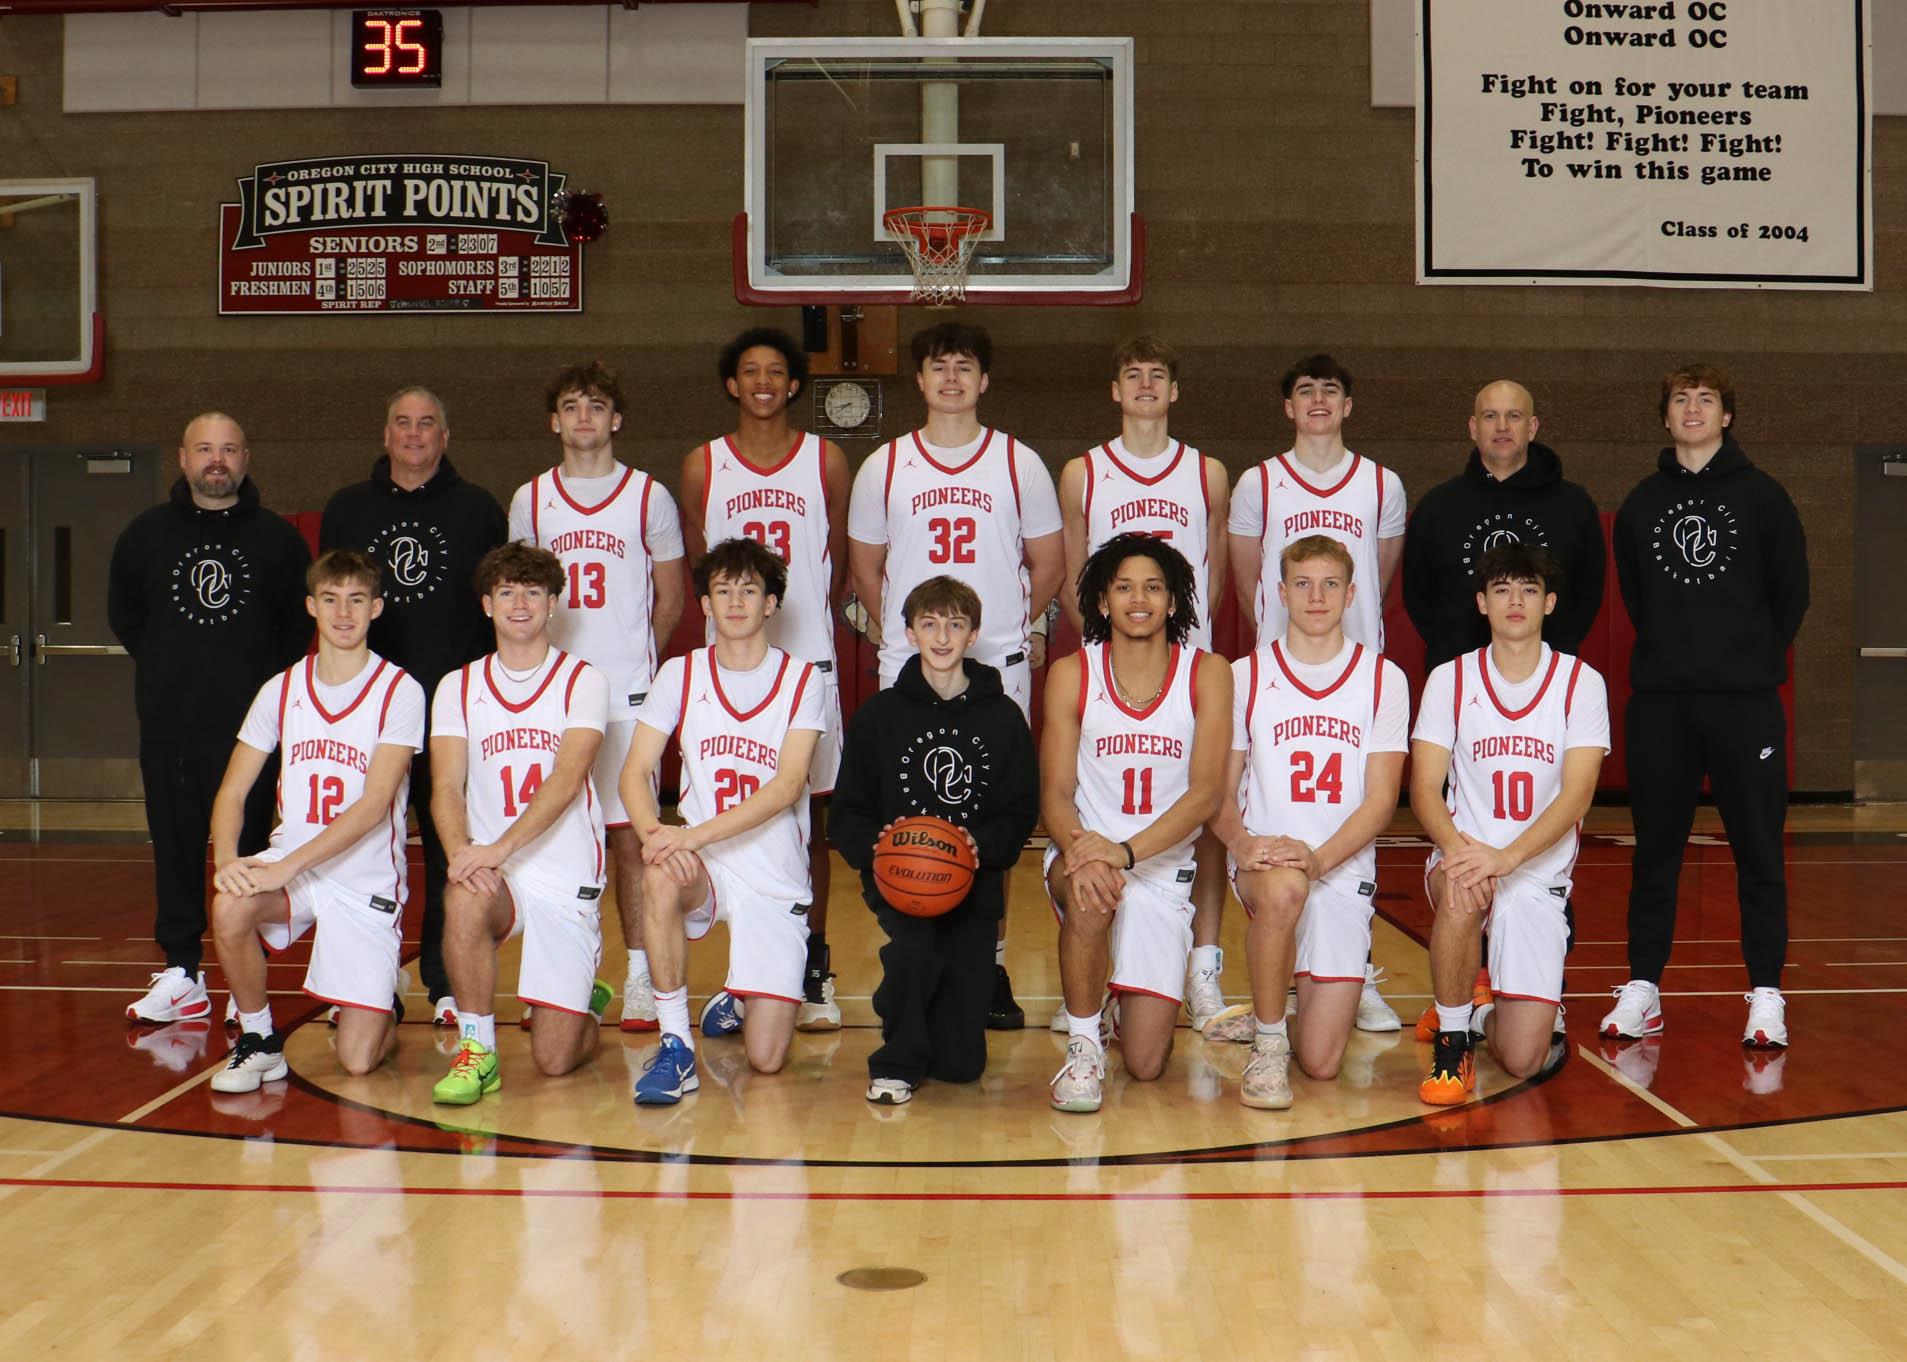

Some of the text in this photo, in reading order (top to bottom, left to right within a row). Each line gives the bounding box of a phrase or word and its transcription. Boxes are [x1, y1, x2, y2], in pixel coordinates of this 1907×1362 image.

[1564, 0, 1727, 21] Onward OC
[364, 20, 425, 74] 35
[1564, 26, 1727, 48] Onward OC
[1481, 74, 1809, 101] Fight on for your team
[1540, 103, 1752, 128] Fight, Pioneers
[1510, 130, 1781, 157] Fight! Fight! Fight!
[287, 163, 514, 181] OREGON CITY HIGH SCHOOL
[1522, 158, 1772, 185] To win this game
[264, 179, 539, 226] SPIRIT POINTS
[309, 236, 497, 254] SENIORS 2nd 2307
[1661, 221, 1809, 242] Class of 2004
[250, 261, 385, 276] JUNIORS 1st 2525
[399, 260, 569, 275] SOPHOMORES 3rd 2212
[231, 281, 385, 297] FRESHMEN 4th 1506
[448, 280, 569, 296] STAFF 5th 1057
[321, 301, 357, 309] SPIRIT
[2, 391, 32, 416] EXIT
[727, 489, 806, 519] PIONEERS
[912, 487, 992, 515] PIONEERS
[1110, 498, 1189, 529] PIONEERS
[1284, 510, 1363, 539] PIONEERS
[550, 530, 625, 559] PIONEERS
[929, 517, 976, 564] 32
[568, 562, 606, 608] 13
[480, 728, 560, 761] PIONEERS
[901, 727, 959, 764] Oregon
[1273, 715, 1360, 749] PIONEERS
[290, 738, 368, 774] PIONEERS
[1096, 734, 1183, 759] PIONEERS
[1472, 736, 1554, 764] PIONEERS
[500, 763, 543, 817] 14
[1121, 767, 1153, 815] 11
[1290, 750, 1343, 804] 24
[305, 773, 344, 825] 12
[1492, 770, 1533, 821] 10
[892, 831, 958, 857] Wilson
[888, 865, 953, 883] EVOLUTION
